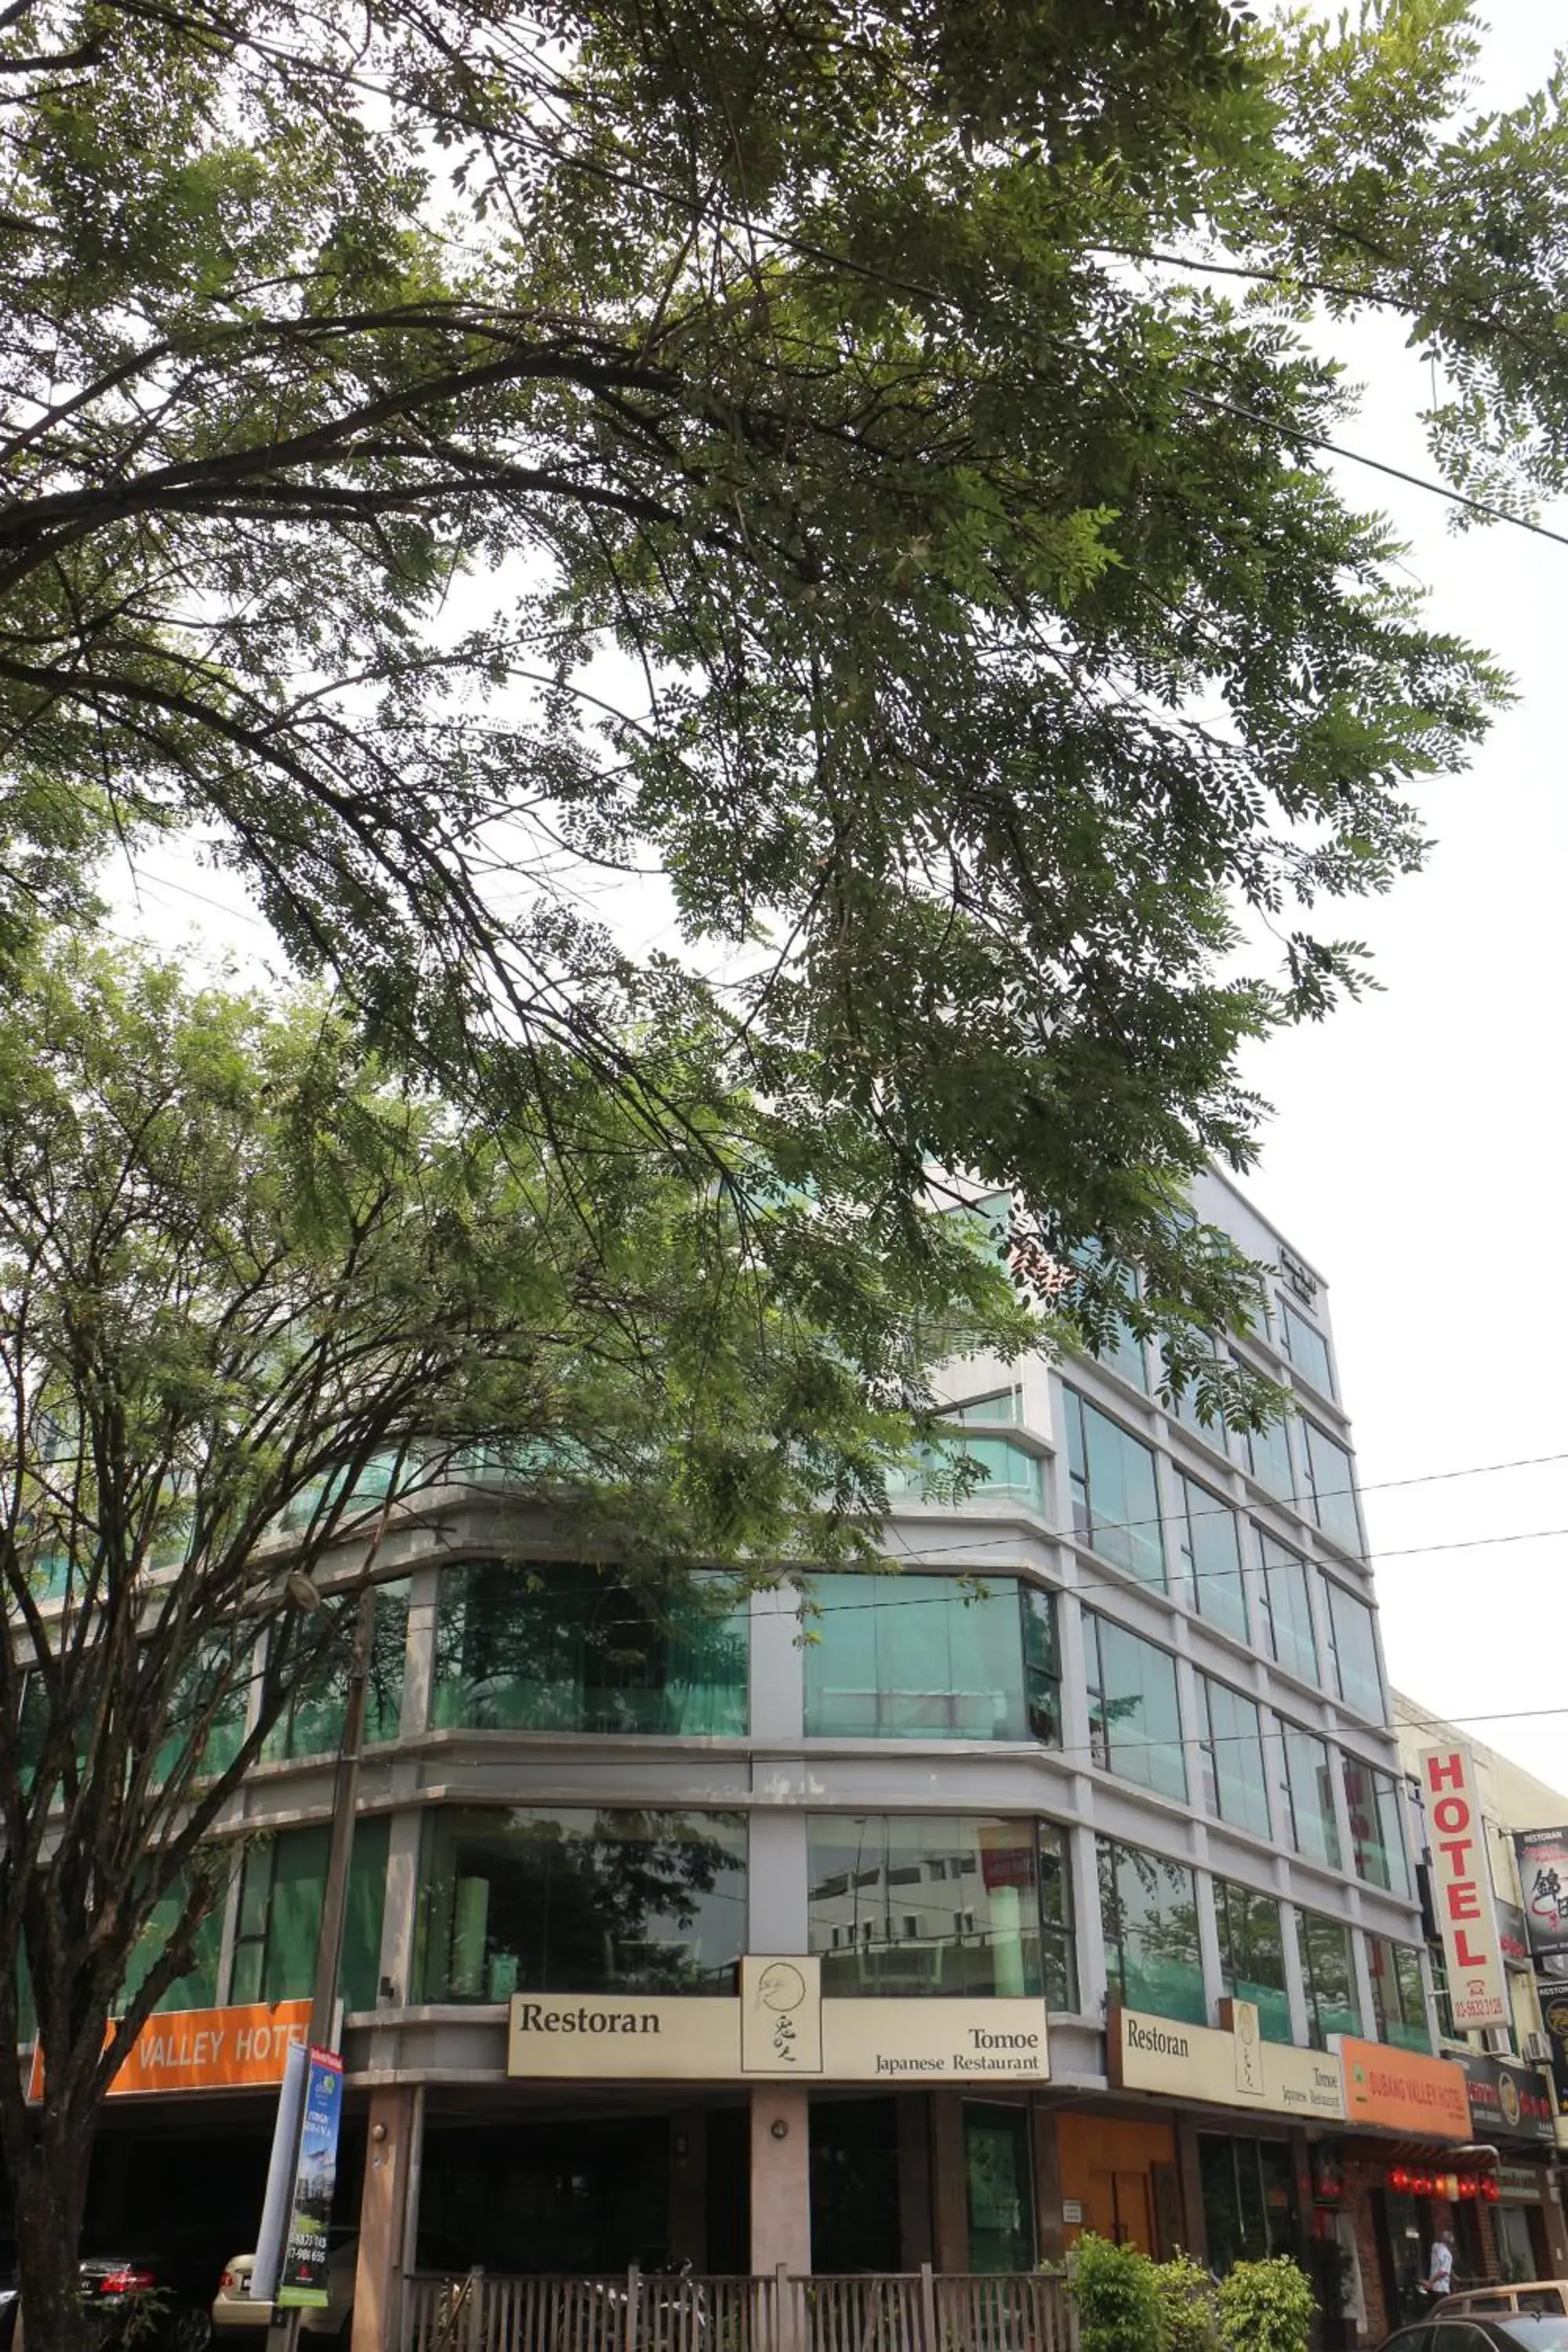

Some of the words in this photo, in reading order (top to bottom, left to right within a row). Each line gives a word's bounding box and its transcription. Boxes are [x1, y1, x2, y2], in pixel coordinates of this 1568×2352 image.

[1428, 1754, 1487, 1968] HOTEL
[519, 2003, 661, 2033] Restoran
[139, 2031, 225, 2069] VALLEY
[968, 2027, 1039, 2049] Tomoe
[1127, 2019, 1189, 2058] Restoran
[875, 2054, 945, 2075] Japanese
[953, 2054, 1039, 2071] Restaurant
